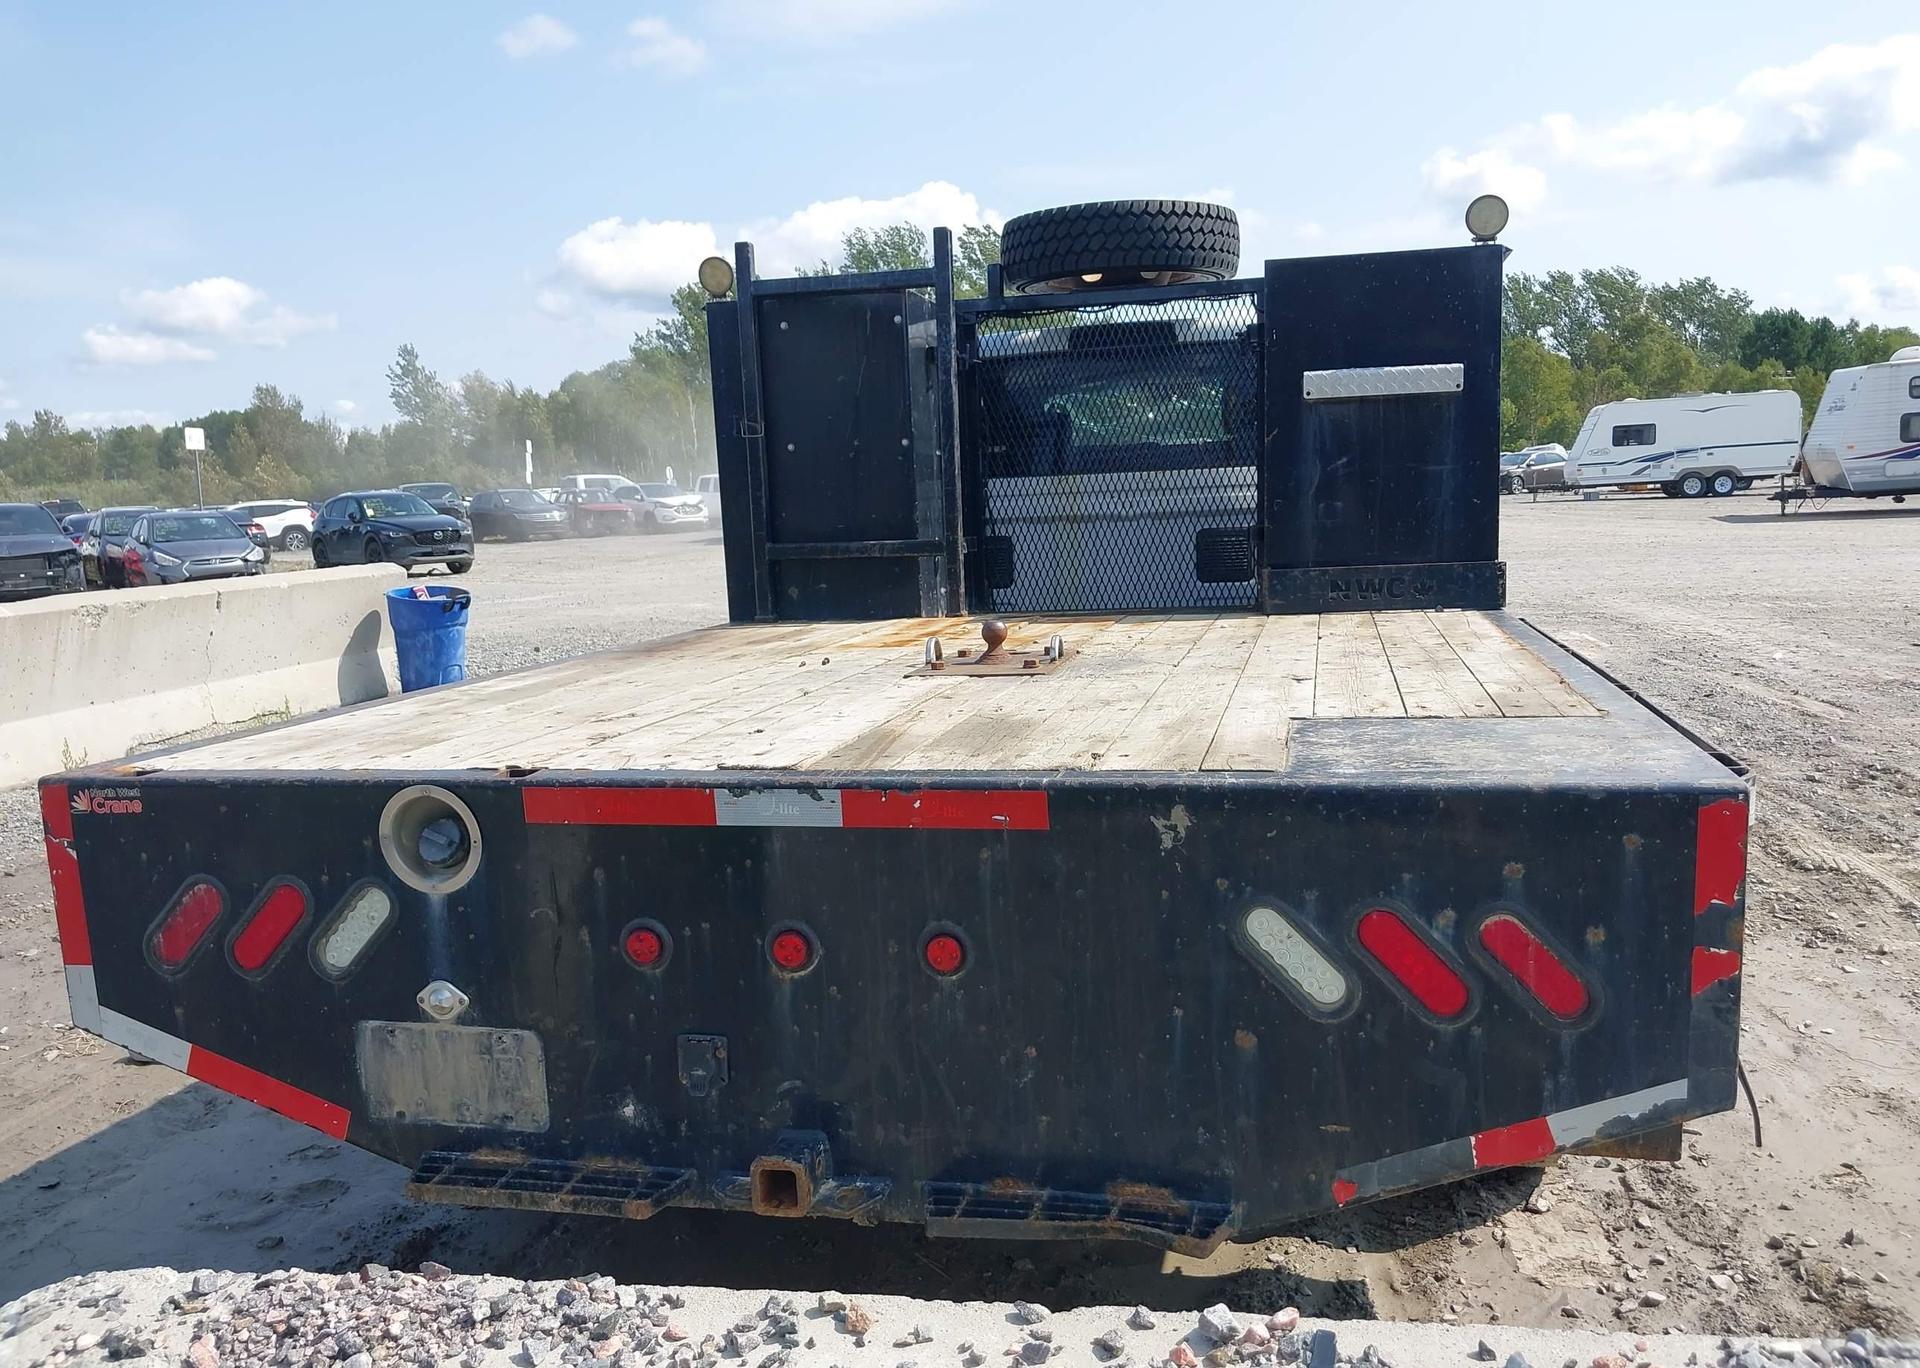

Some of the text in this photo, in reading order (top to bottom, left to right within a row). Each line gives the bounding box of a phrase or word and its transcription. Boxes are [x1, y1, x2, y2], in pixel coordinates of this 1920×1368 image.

[1329, 577, 1406, 601] NWC
[90, 788, 141, 797] North West
[92, 797, 142, 814] Crane
